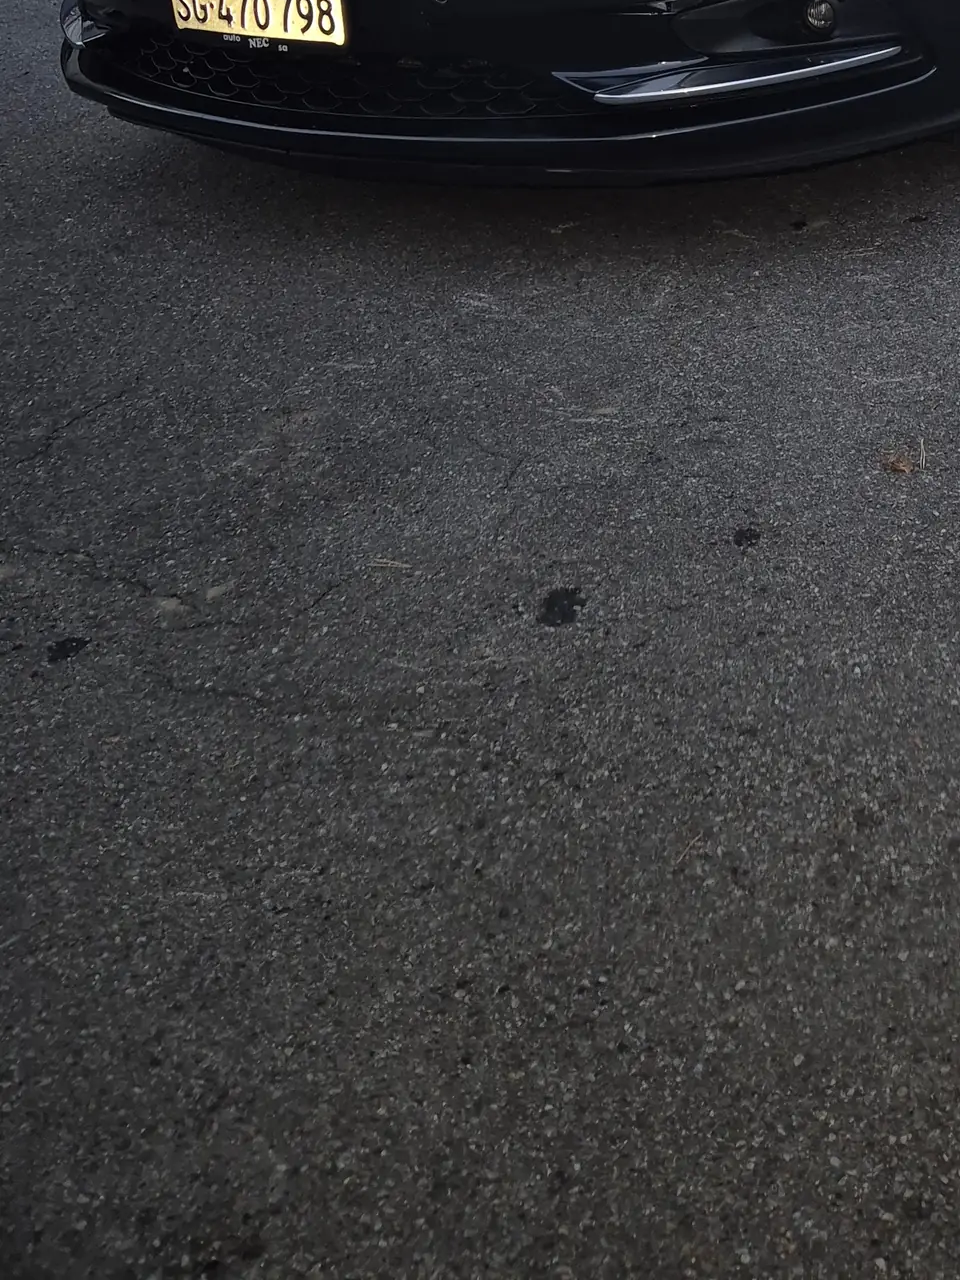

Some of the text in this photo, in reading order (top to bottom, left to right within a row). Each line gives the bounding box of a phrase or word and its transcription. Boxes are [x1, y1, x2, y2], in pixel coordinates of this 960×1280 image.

[223, 34, 288, 52] auto NEC sa
